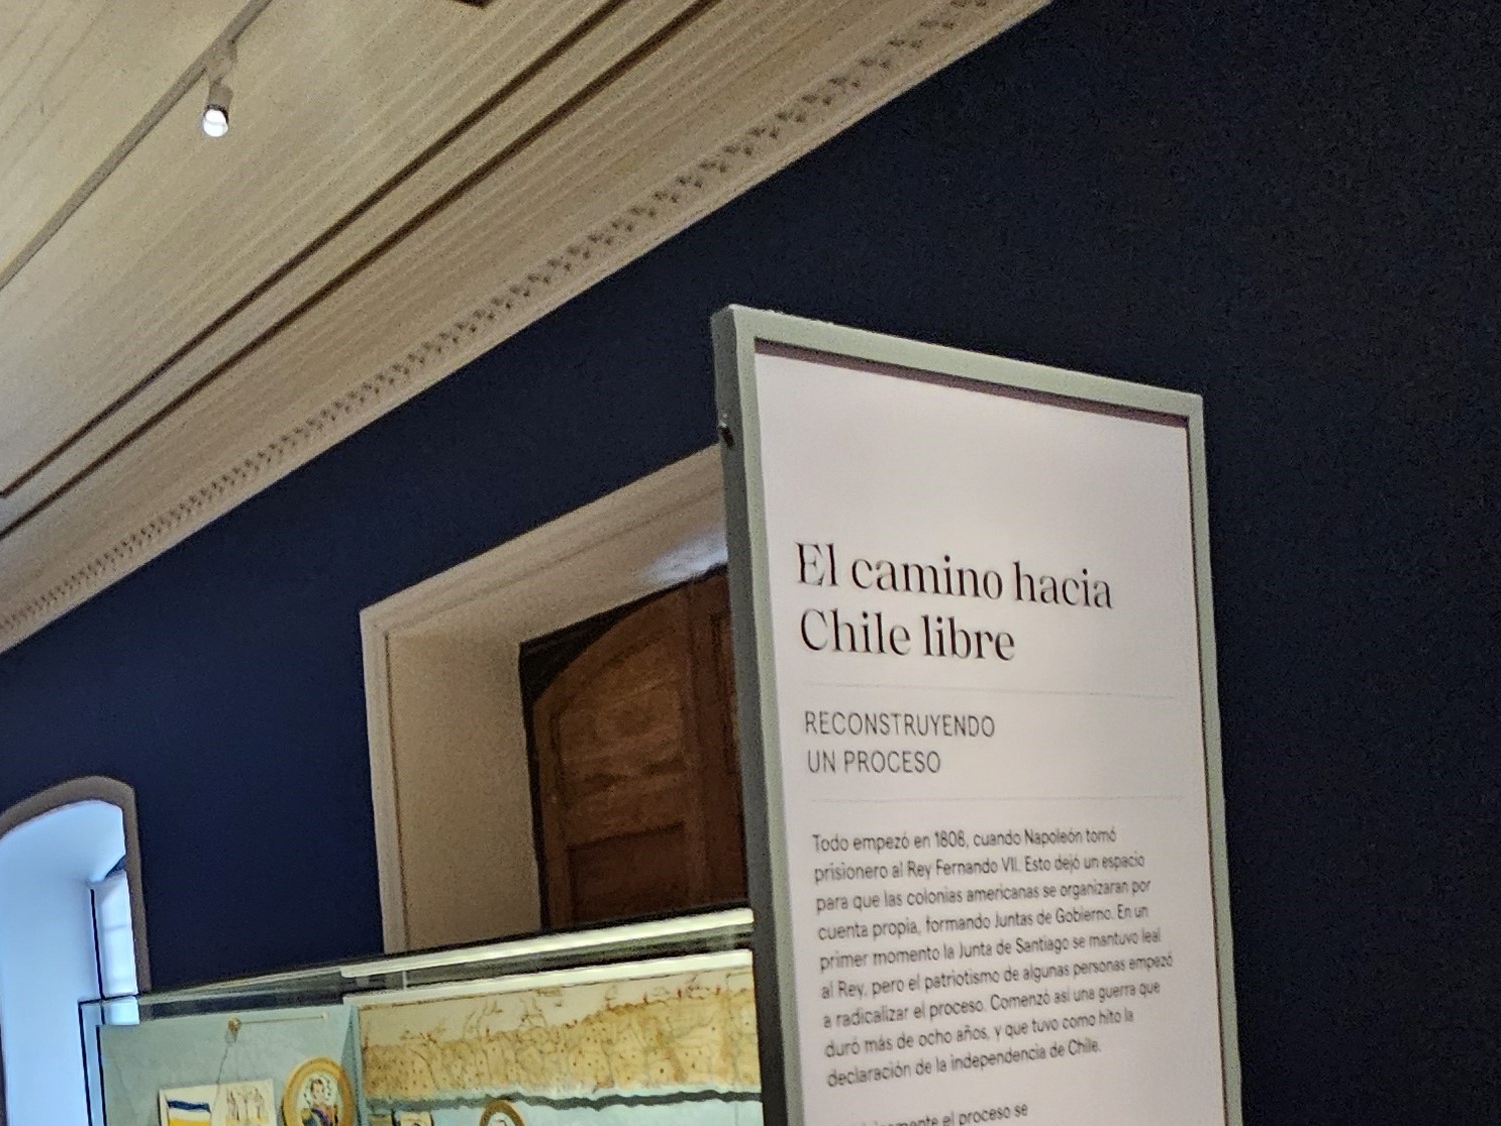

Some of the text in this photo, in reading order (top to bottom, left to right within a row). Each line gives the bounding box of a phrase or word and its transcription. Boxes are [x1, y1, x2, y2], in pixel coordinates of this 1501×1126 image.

[795, 541, 1114, 609] El camino hacia
[799, 608, 1016, 661] Chile libre
[804, 710, 995, 738] RECONSTRUYENDO
[807, 750, 941, 773] UN PROCESO
[812, 826, 1116, 854] Todo empezó en 1808, cuando Napoleón tomó
[815, 862, 888, 886] prisionero
[892, 862, 903, 878] al
[907, 860, 931, 880] Rey
[936, 856, 998, 876] Fernando
[1025, 855, 1051, 872] Esto
[1055, 853, 1080, 874] dejó
[1084, 857, 1098, 869] un
[1102, 851, 1145, 871] espacio
[816, 879, 1151, 914] para que las colonias americanas se organizaran por
[818, 923, 868, 940] cuenta
[995, 912, 1033, 928] Juntas
[1036, 910, 1052, 926] de
[1117, 904, 1131, 919] En
[1134, 905, 1148, 918] un
[820, 926, 1161, 974] primer momento la Junta de Santiago se mantuvo leal
[822, 981, 833, 999] al
[873, 981, 905, 998] pero
[908, 973, 920, 991] el
[925, 969, 1000, 993] patriotismo
[1004, 965, 1019, 982] de
[1023, 964, 1070, 983] algunas
[1073, 958, 1126, 978] personas
[1129, 951, 1173, 972] empezó
[836, 1005, 908, 1027] radicalizar
[913, 1001, 926, 1018] el
[990, 989, 1050, 1011] Comenzó
[1073, 988, 1095, 1002] una
[1099, 983, 1136, 1003] guerra
[1139, 981, 1161, 998] que
[825, 1040, 860, 1058] duró
[865, 1034, 893, 1052] más
[897, 1032, 914, 1050] de
[919, 1029, 952, 1047] ocho
[994, 1026, 1002, 1041] y
[1005, 1021, 1028, 1038] que
[1032, 1018, 1059, 1032] tuvo
[1062, 1013, 1096, 1028] como
[1098, 1008, 1122, 1025] hito
[1124, 1007, 1134, 1023] la
[827, 1060, 911, 1087] declaración
[915, 1059, 932, 1076] de
[936, 1056, 947, 1073] la
[951, 1043, 1046, 1071] independencia
[1050, 1041, 1065, 1058] de
[1014, 1103, 1029, 1117] se
